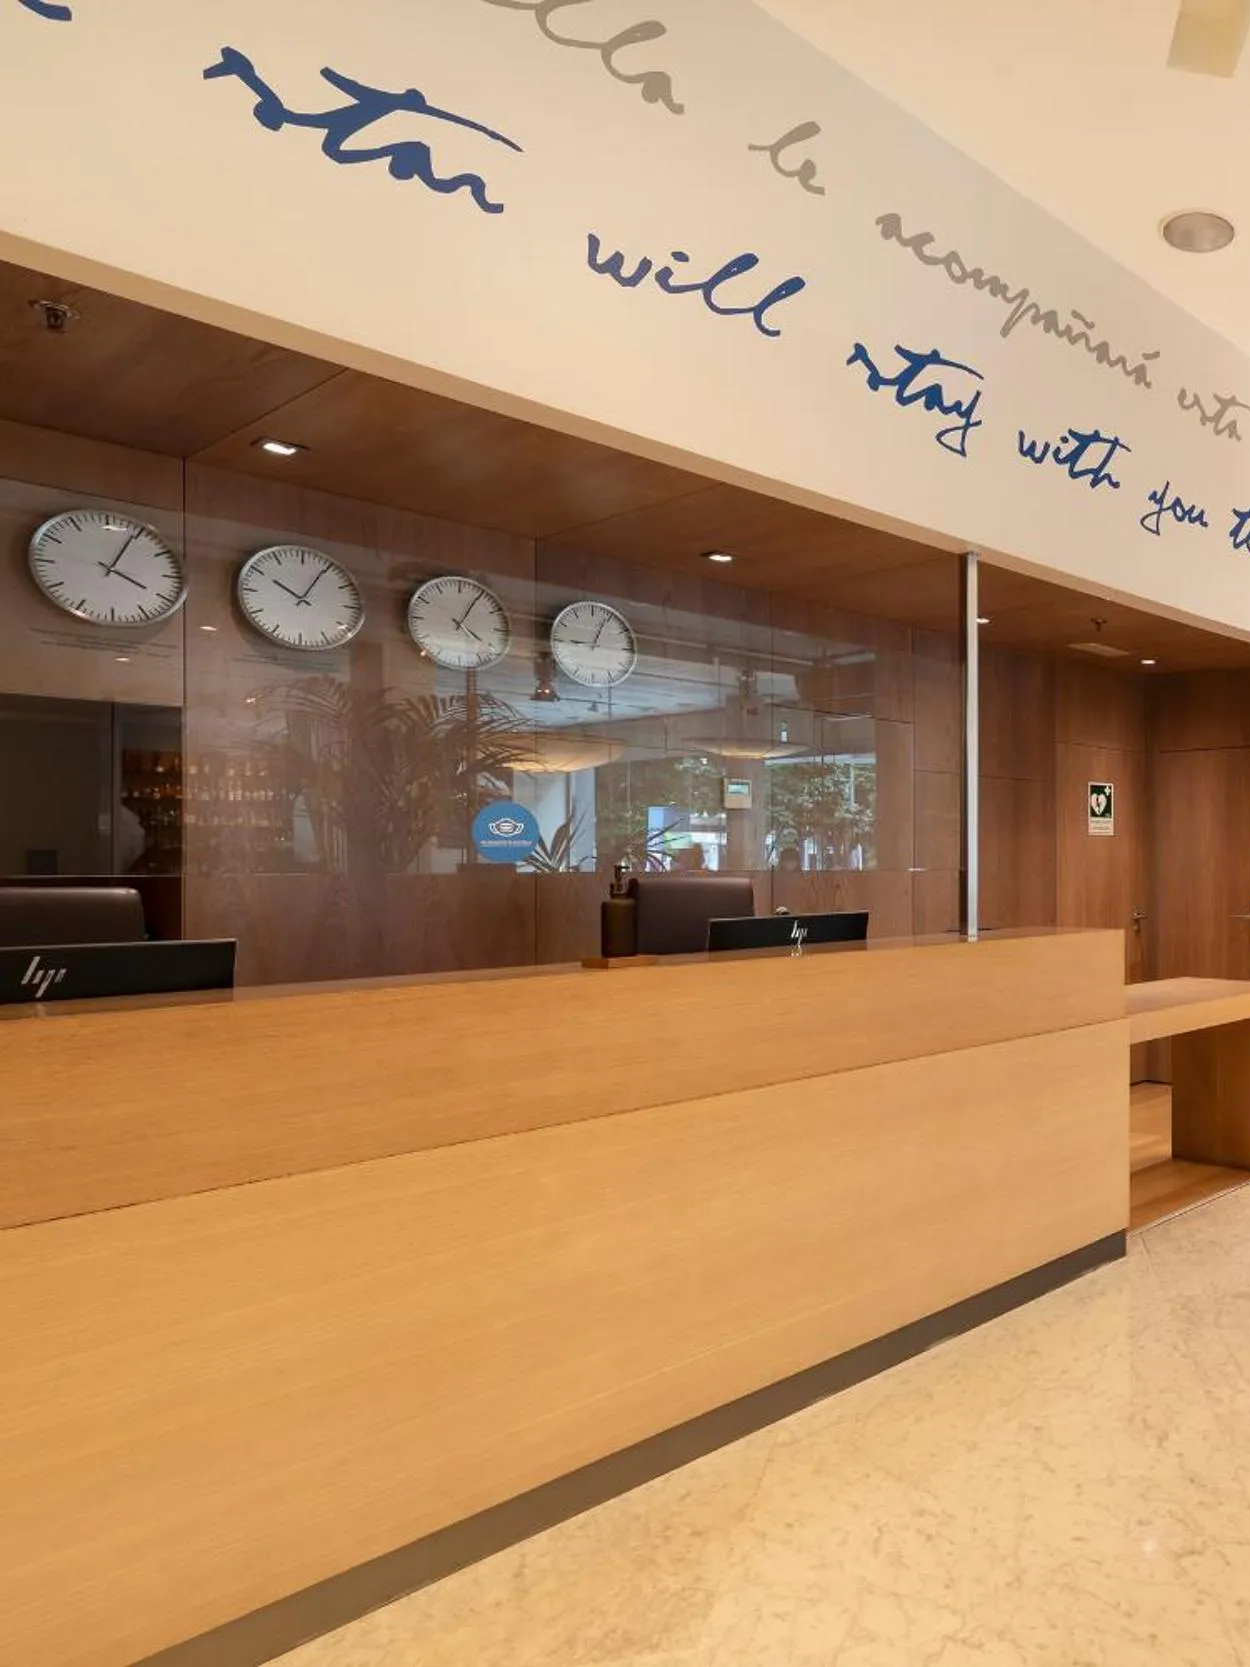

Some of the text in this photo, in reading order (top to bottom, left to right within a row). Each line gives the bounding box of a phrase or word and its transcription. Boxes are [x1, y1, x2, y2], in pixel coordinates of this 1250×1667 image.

[203, 46, 525, 215] star
[587, 233, 807, 338] will
[846, 342, 985, 459] stay
[1018, 428, 1133, 490] with
[1140, 480, 1208, 537] you
[748, 121, 826, 196] le
[876, 212, 1161, 389] acompañará
[21, 955, 67, 998] hp
